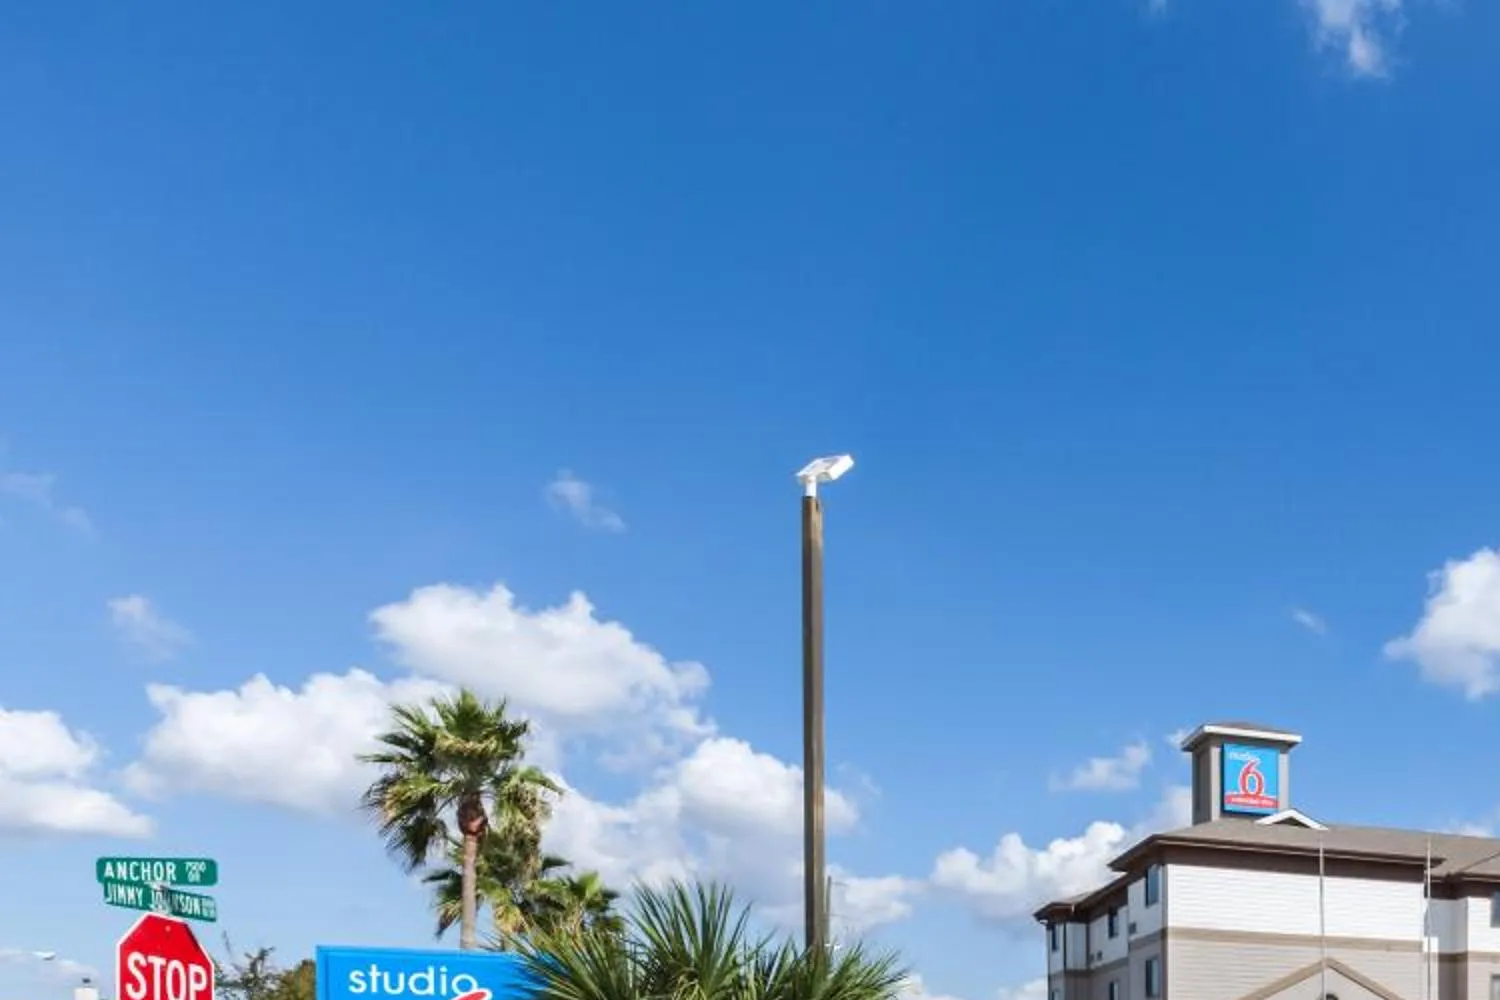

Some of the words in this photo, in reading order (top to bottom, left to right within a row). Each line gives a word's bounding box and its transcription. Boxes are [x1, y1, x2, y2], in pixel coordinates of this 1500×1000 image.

[1239, 759, 1264, 796] 6
[104, 861, 176, 881] ANCHOR
[105, 882, 143, 907] JIMMY
[349, 964, 477, 997] studio
